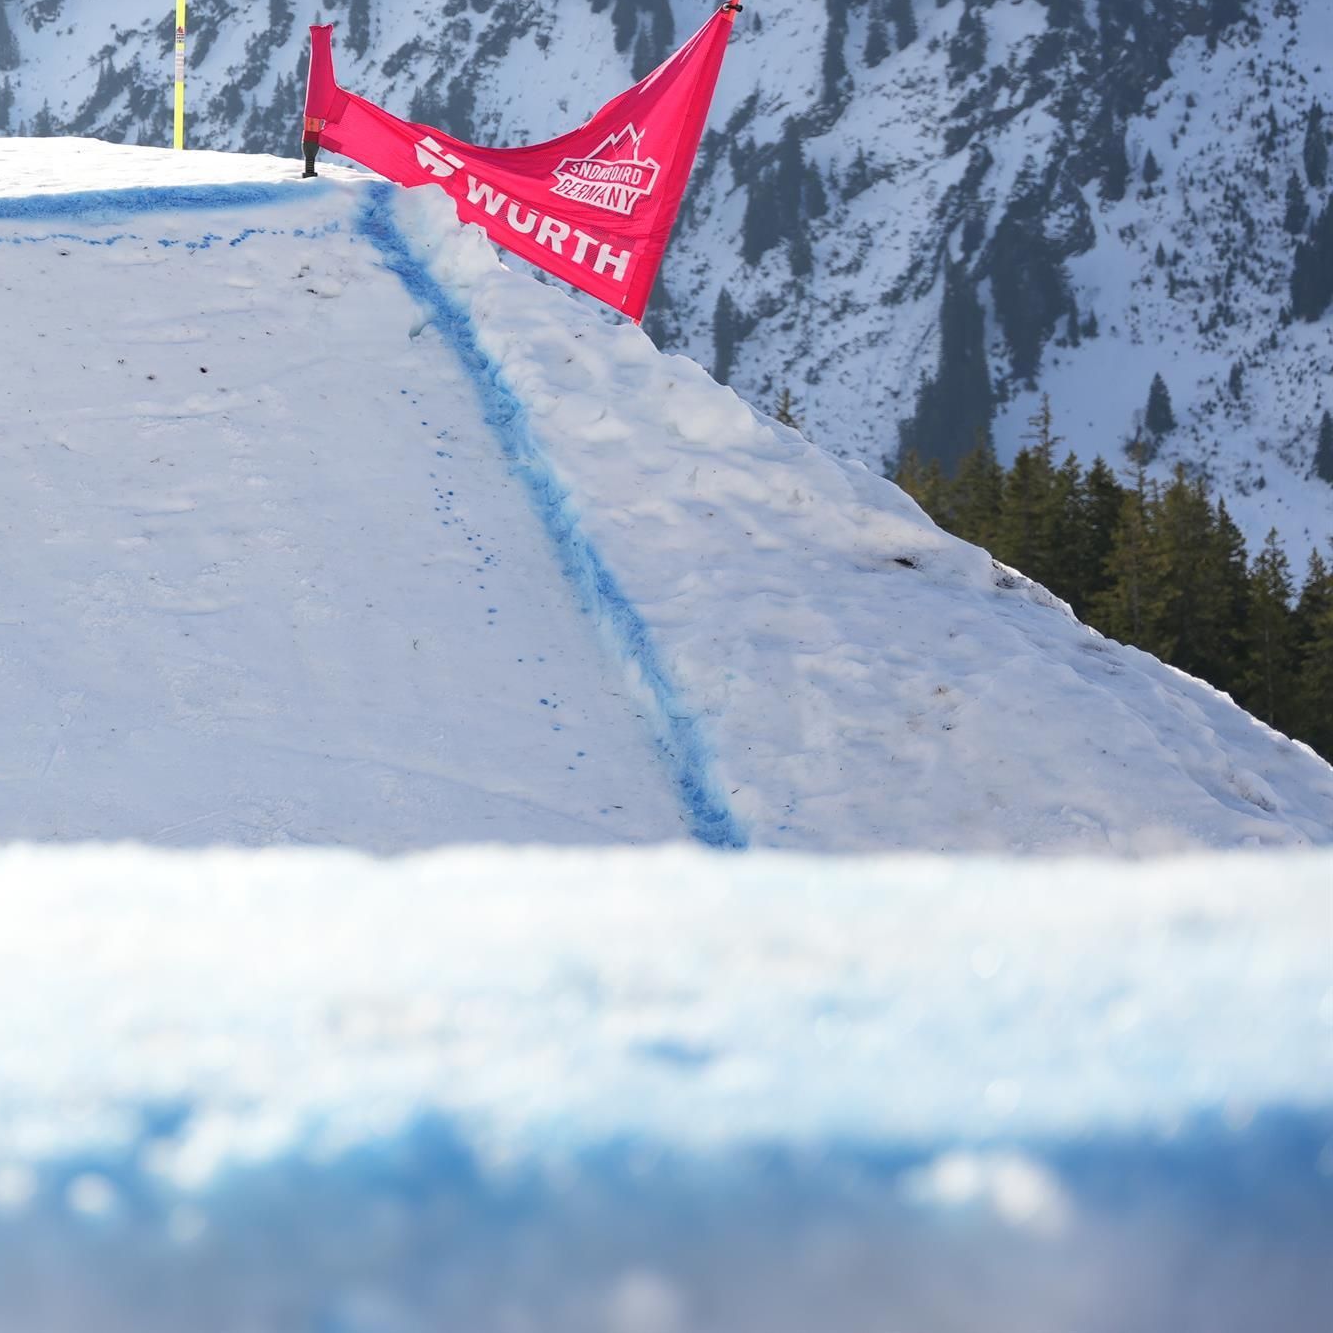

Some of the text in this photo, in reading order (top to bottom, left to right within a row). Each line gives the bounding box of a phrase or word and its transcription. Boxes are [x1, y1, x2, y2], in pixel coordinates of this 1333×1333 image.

[569, 161, 643, 185] SNOWBOARD
[556, 178, 636, 211] GERMANY
[465, 175, 632, 282] WÜRTH
